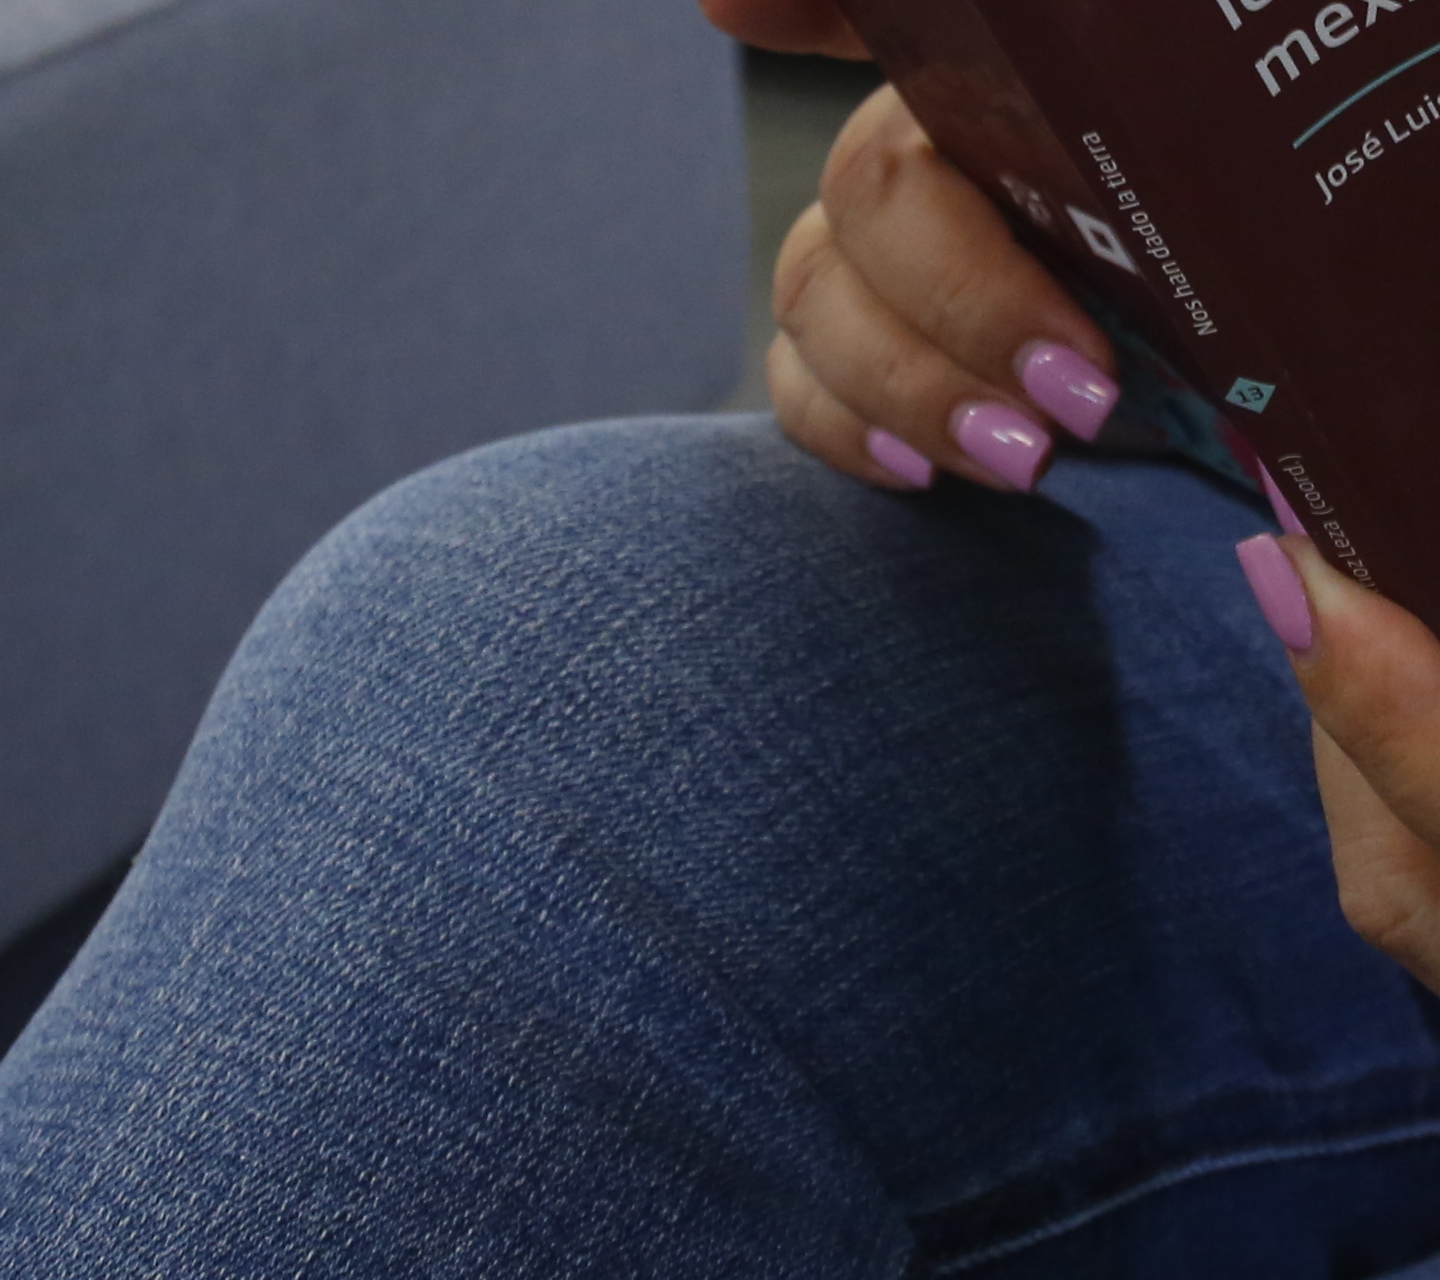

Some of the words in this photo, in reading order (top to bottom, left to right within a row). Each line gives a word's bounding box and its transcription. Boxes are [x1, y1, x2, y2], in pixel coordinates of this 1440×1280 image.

[1082, 131, 1127, 189] tierra
[1315, 131, 1386, 205] José
[1118, 189, 1140, 211] la
[1131, 211, 1170, 259] dado
[1162, 261, 1194, 299] han
[1184, 299, 1218, 336] Nos
